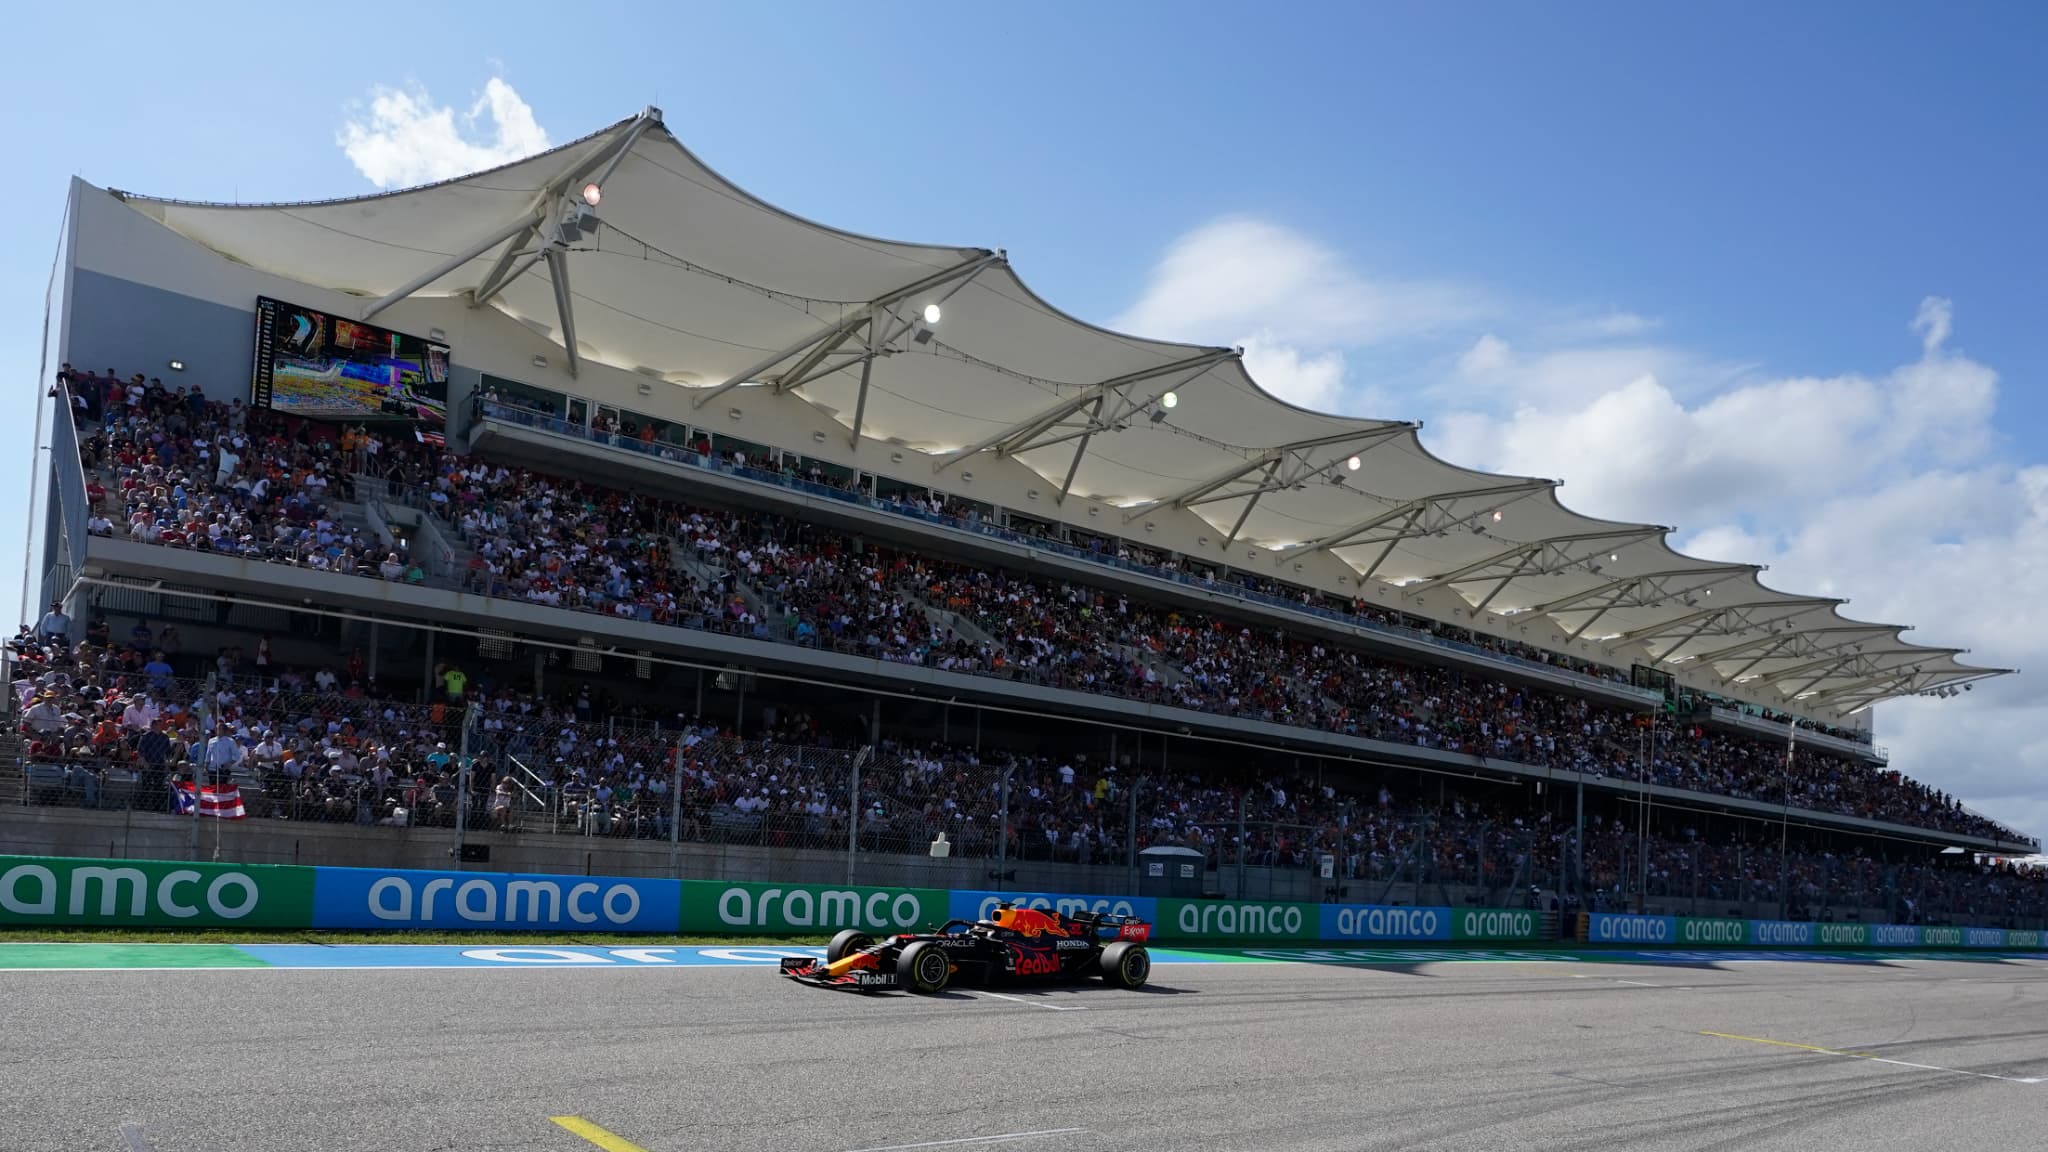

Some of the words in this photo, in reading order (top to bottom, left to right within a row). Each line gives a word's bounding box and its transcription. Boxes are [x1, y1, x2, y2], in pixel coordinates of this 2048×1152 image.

[367, 876, 640, 925] aramco
[718, 887, 921, 927] aramco
[1179, 903, 1302, 934] aramco
[1338, 908, 1436, 936] aramco
[1465, 911, 1531, 936] aramco
[1600, 916, 1666, 940] aramco
[1124, 926, 1145, 937] Exxon
[1685, 920, 1742, 942] aramco
[1759, 923, 1808, 943] aramco
[1821, 925, 1865, 943] aramco
[1876, 927, 1914, 944] aramco
[1925, 928, 1960, 944] aramco
[1969, 930, 2000, 945] aramco
[2009, 932, 2037, 945] aramco
[936, 940, 976, 948] ORACLE
[861, 974, 887, 985] Mobil
